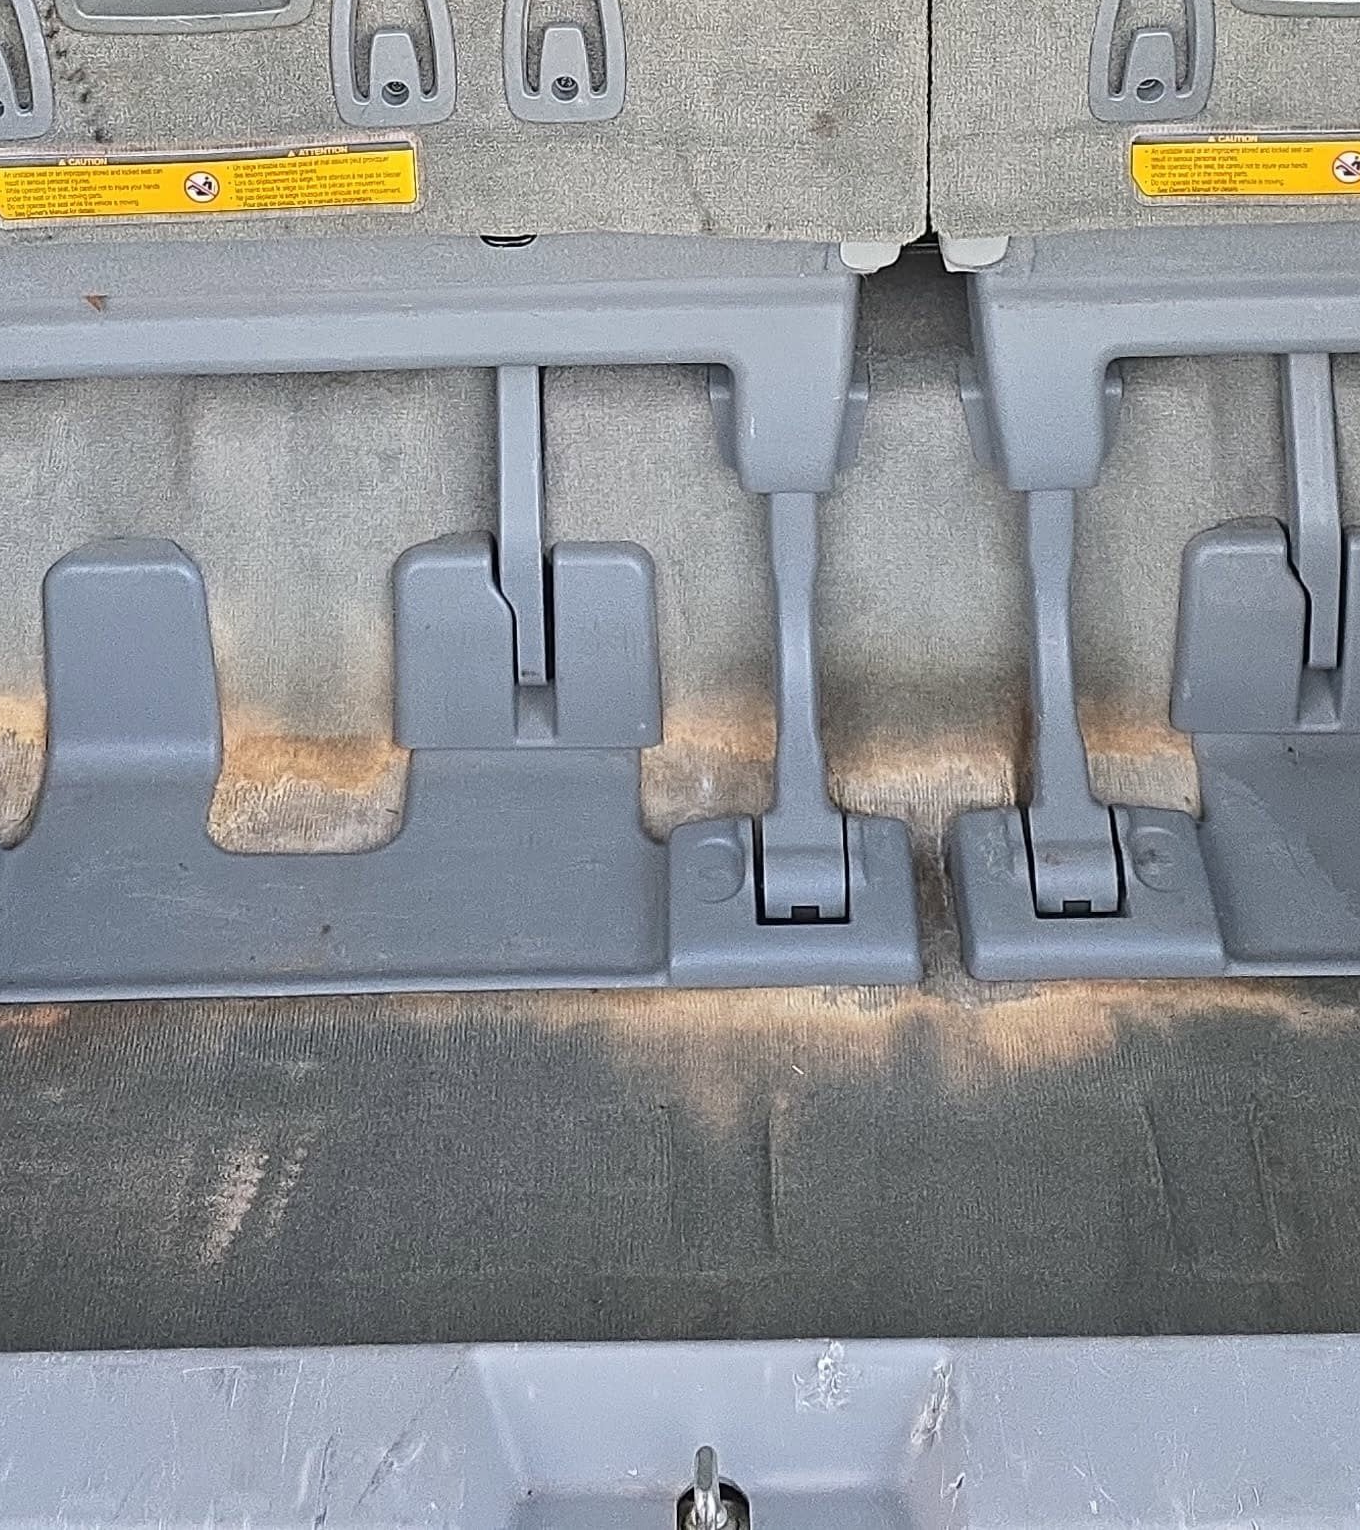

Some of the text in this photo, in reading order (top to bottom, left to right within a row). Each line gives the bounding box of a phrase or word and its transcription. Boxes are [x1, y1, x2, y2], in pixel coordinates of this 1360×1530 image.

[1218, 135, 1258, 143] CAUTION
[299, 146, 349, 156] ATTENTION
[68, 158, 108, 166] CAUTION
